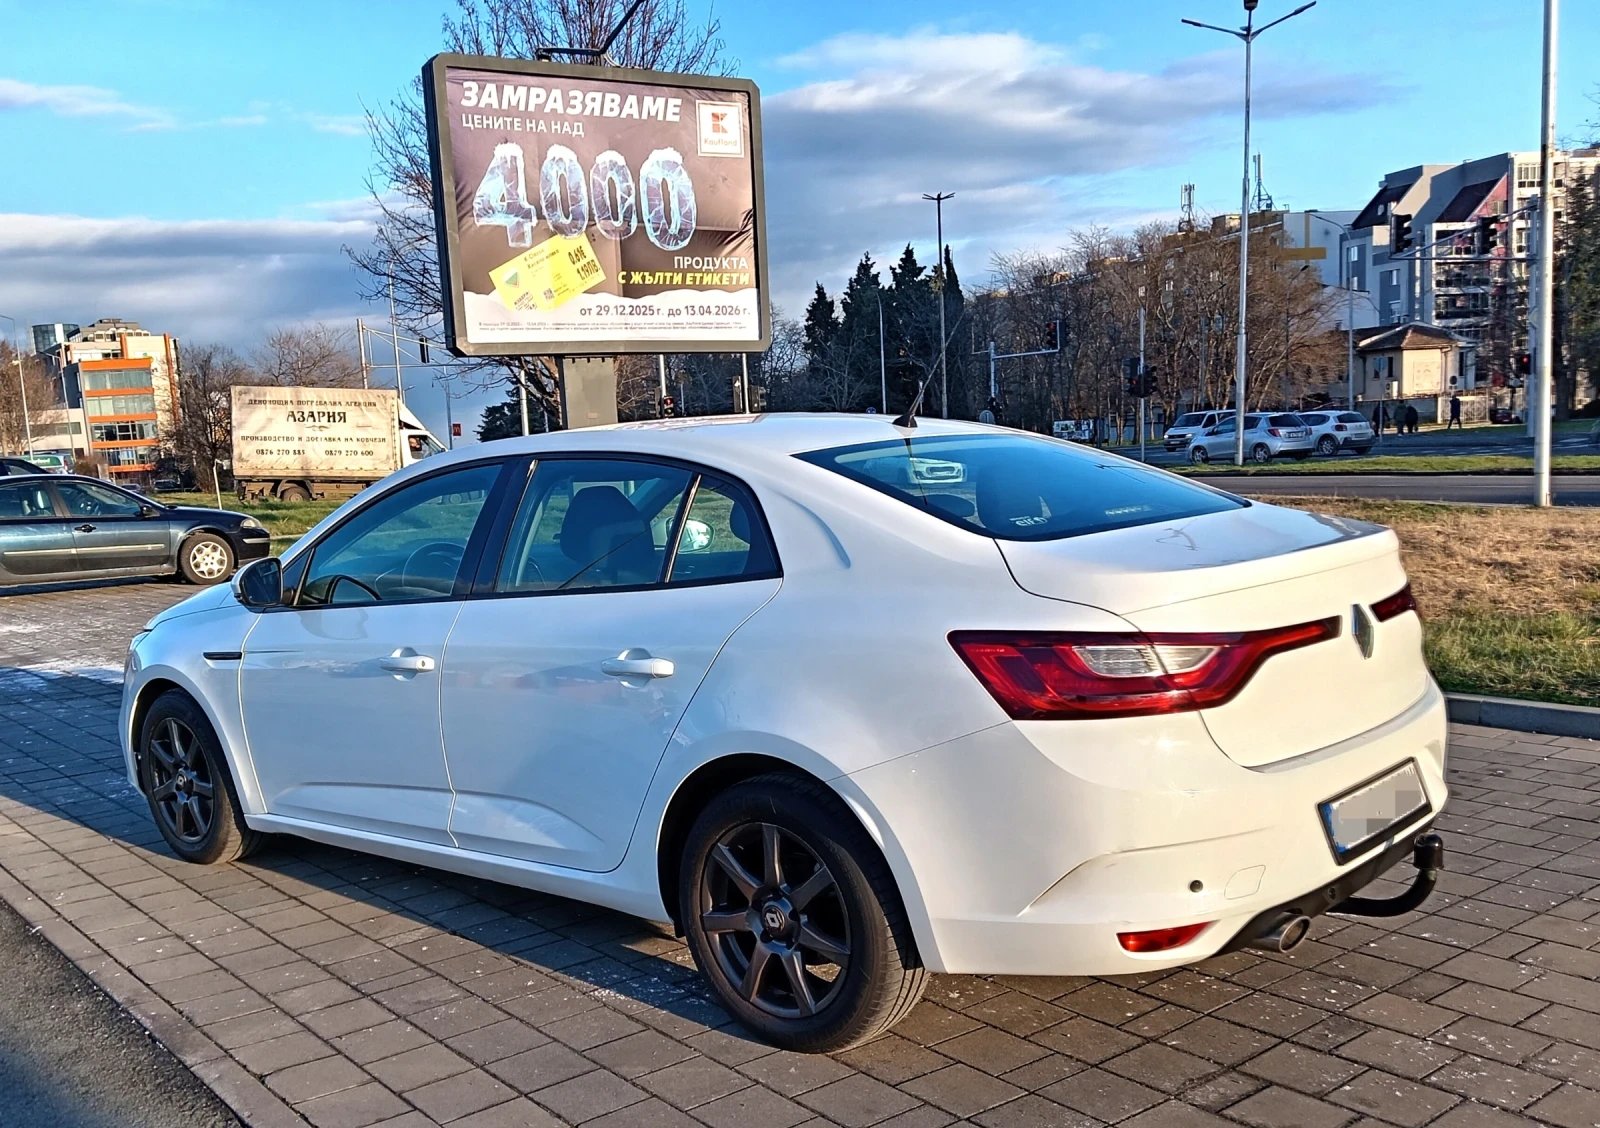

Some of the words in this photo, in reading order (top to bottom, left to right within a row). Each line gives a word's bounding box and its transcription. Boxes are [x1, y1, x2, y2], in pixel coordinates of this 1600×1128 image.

[461, 81, 682, 122] ЗАМРАЗЯВАМЕ
[461, 113, 522, 131] ЦЕНИТЕ
[526, 119, 547, 133] НА
[551, 121, 585, 137] НАД
[704, 138, 737, 146] Kaufland
[472, 143, 697, 251] 4000
[568, 245, 587, 265] 0.61€
[674, 256, 749, 271] ПРОДУКТА
[617, 271, 627, 284] С
[629, 271, 683, 284] ЖЪЛТИ
[686, 271, 750, 285] ЕТИКЕТИ
[580, 306, 592, 316] от
[595, 304, 655, 316] 29.12.2025
[667, 307, 682, 318] до
[684, 305, 741, 316] 13.04.2026
[286, 410, 347, 423] АЗАРИЯ
